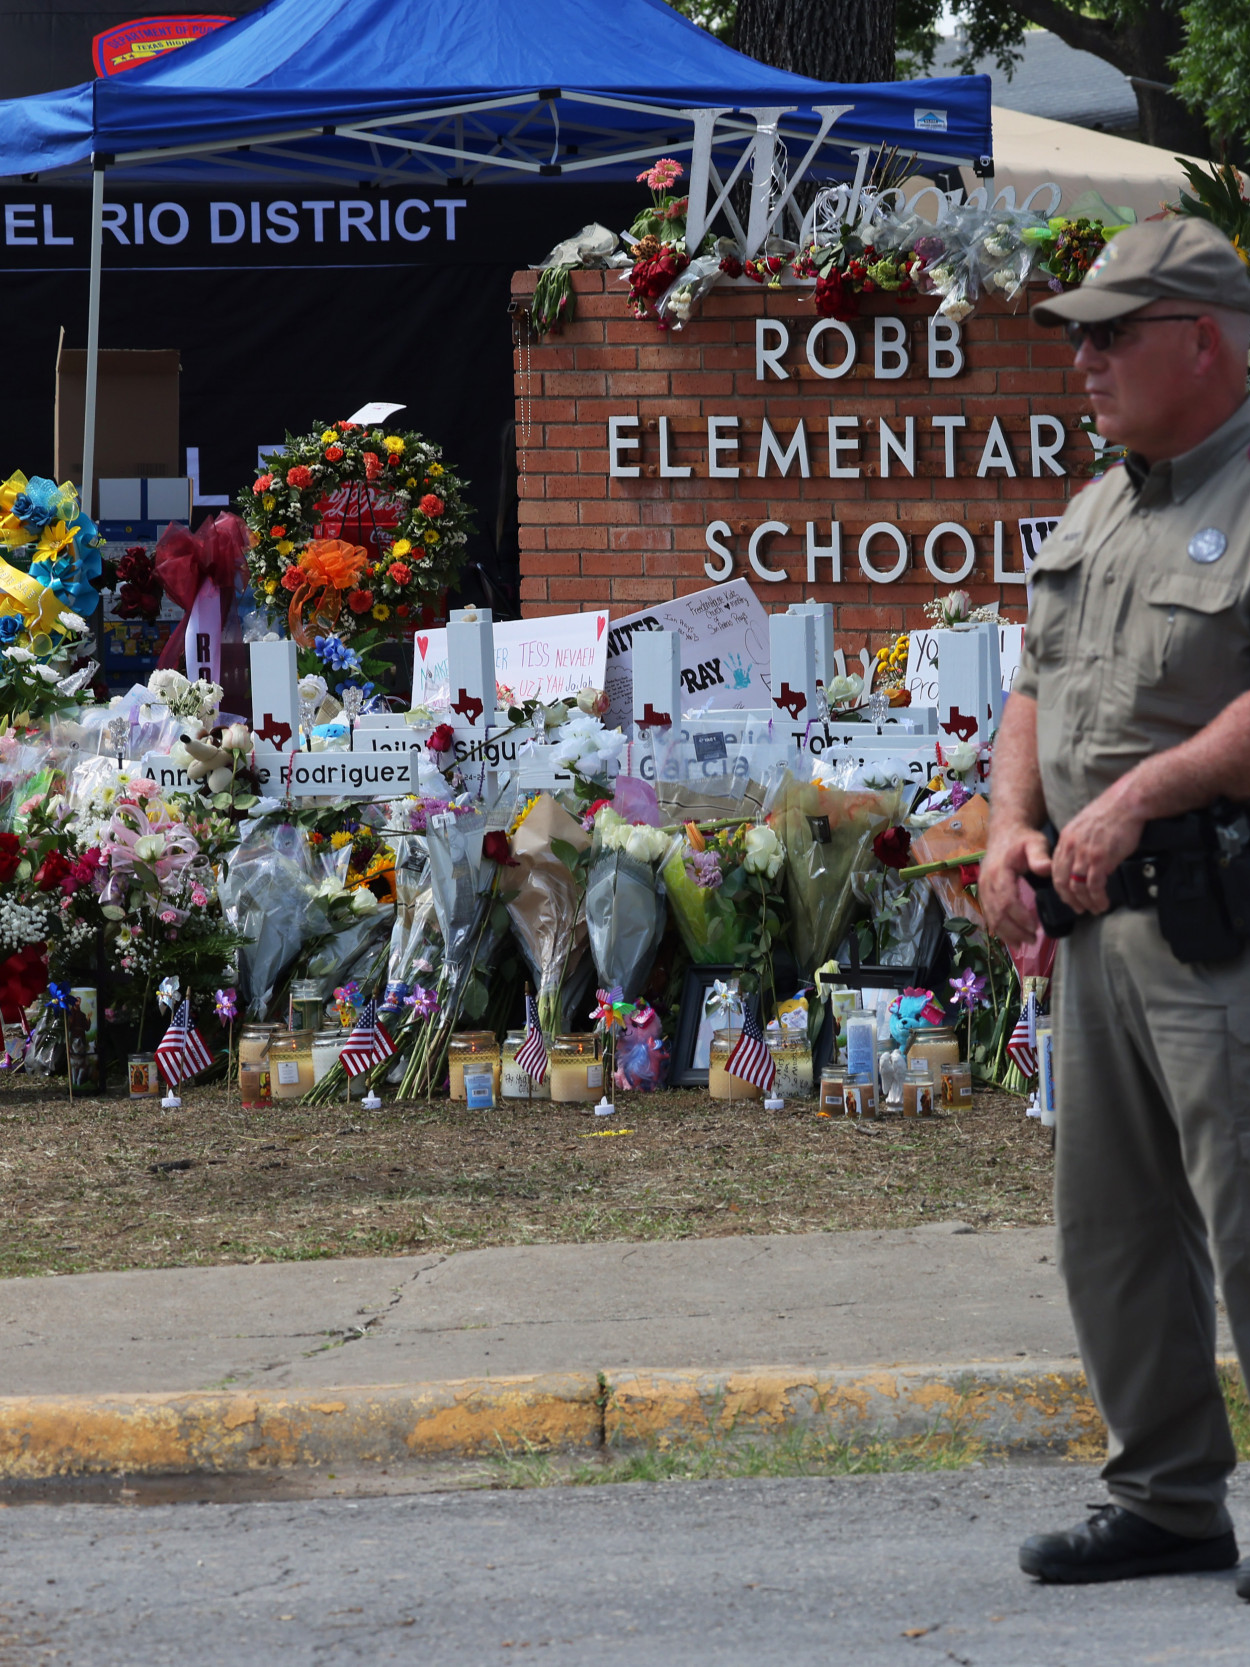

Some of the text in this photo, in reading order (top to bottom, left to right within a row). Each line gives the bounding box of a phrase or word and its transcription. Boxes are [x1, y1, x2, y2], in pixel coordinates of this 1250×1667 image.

[107, 26, 172, 49] DEPARTMENT
[175, 25, 189, 35] OF
[136, 42, 164, 51] TEXAS
[4, 199, 467, 245] EL RIO DISTRICT
[755, 316, 965, 381] ROBB
[704, 519, 1028, 583] SCHOOL
[519, 640, 550, 668] TESS
[554, 647, 595, 668] NEVAEH
[280, 764, 410, 788] Rodriguez
[639, 754, 749, 781] Garcia
